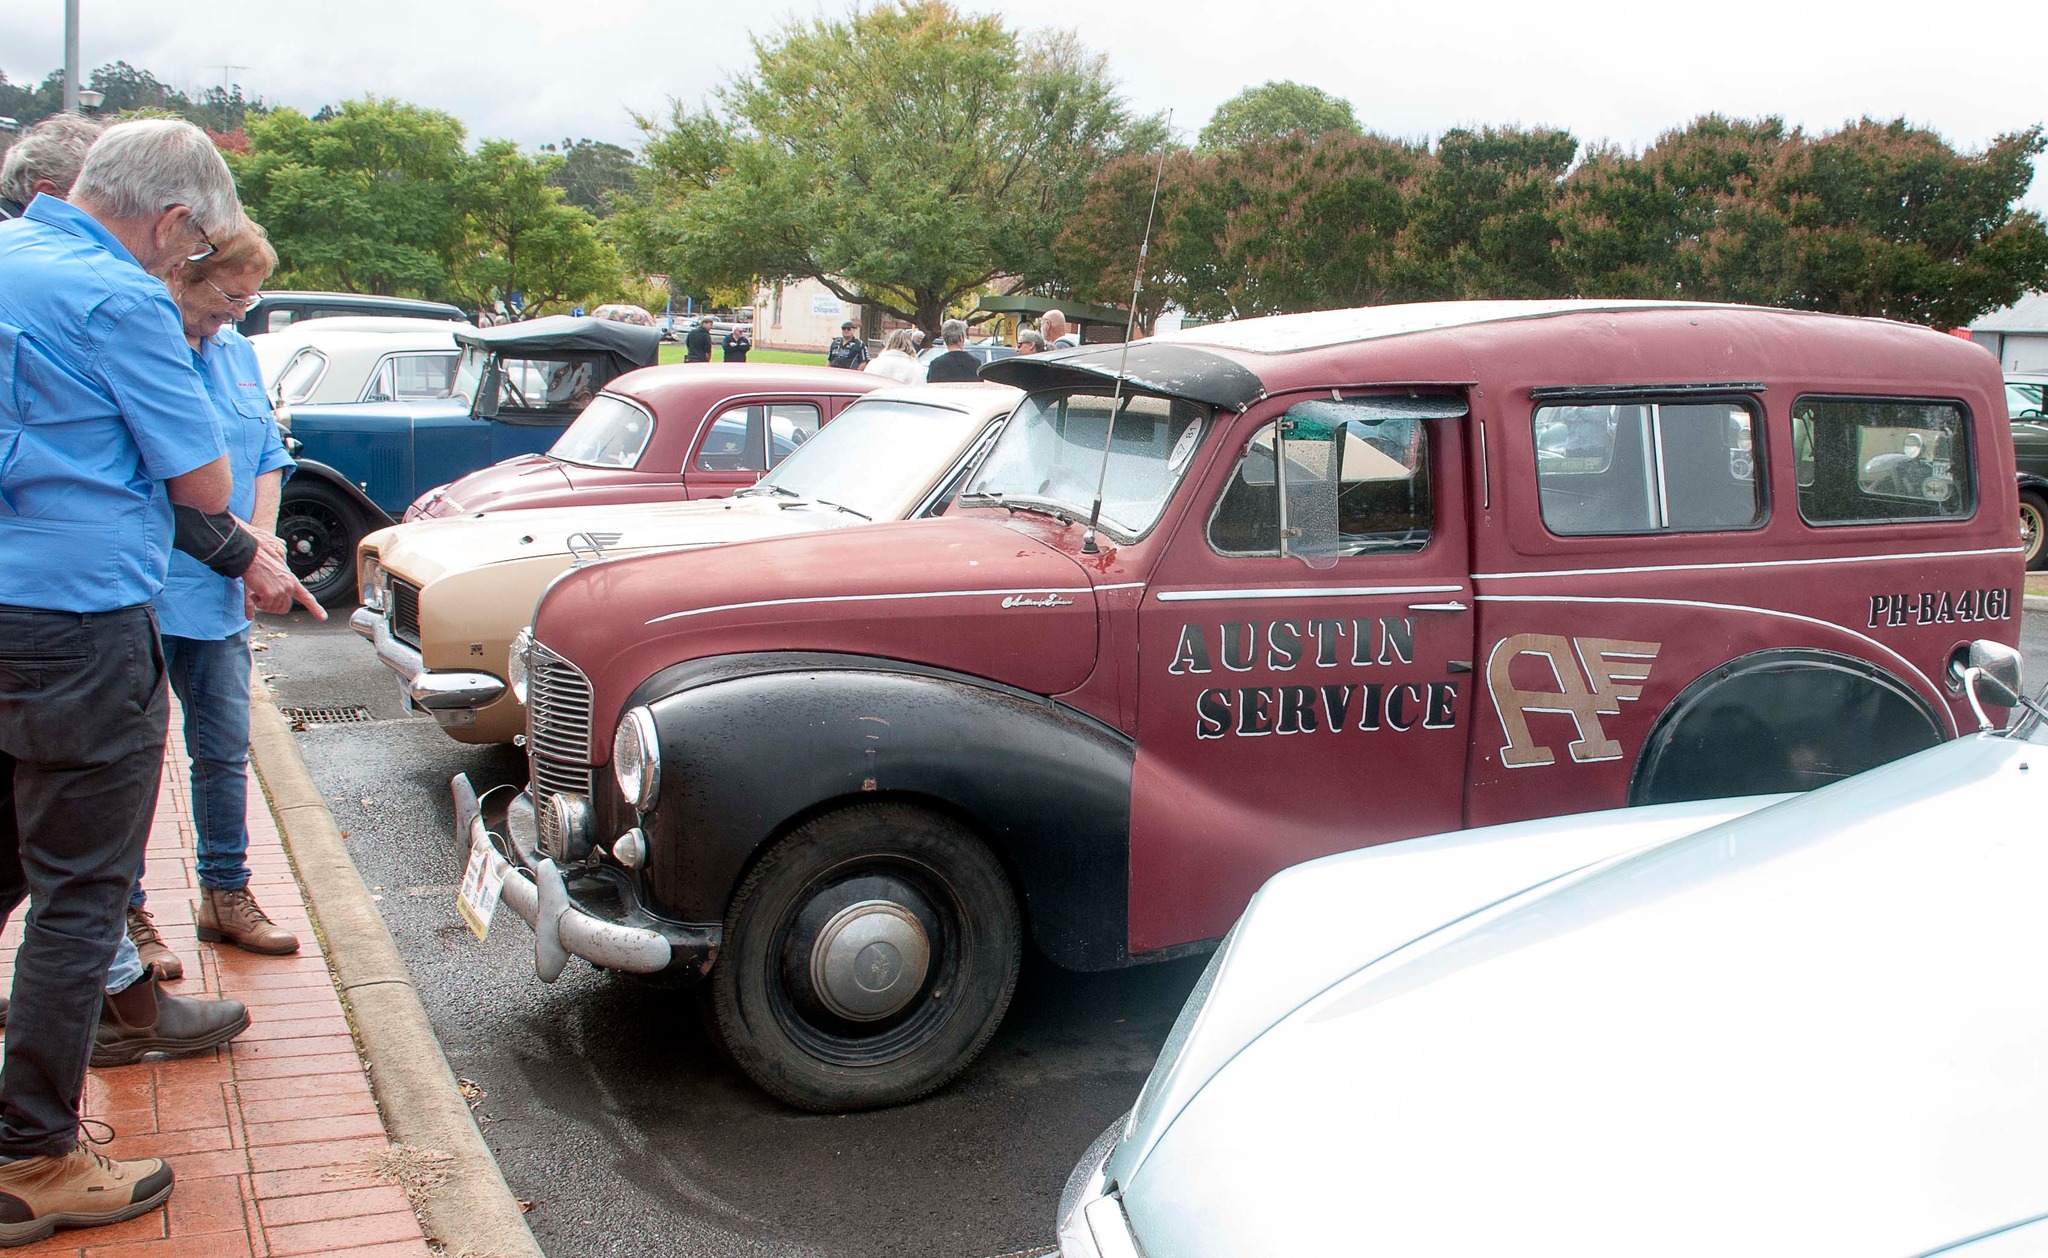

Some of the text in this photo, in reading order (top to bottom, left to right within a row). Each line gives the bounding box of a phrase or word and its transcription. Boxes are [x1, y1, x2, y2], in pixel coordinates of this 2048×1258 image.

[813, 306, 840, 314] Chiropractic
[1168, 616, 1418, 675] AUSTIN
[1197, 681, 1459, 739] SERVICE
